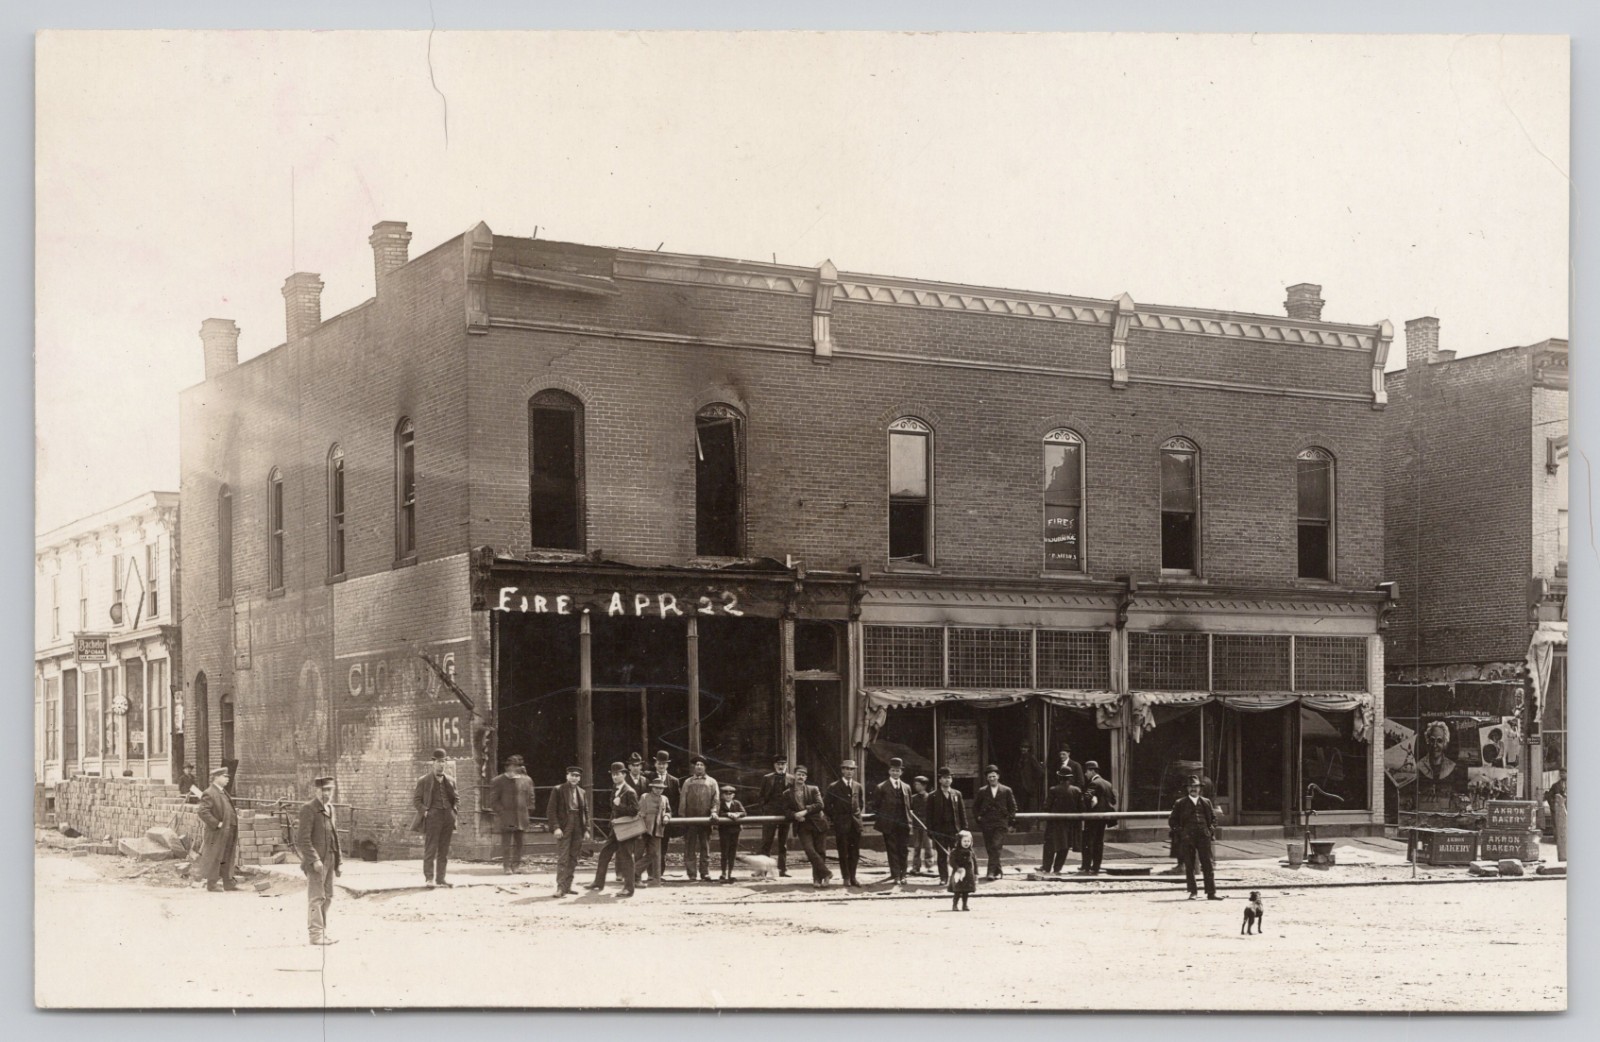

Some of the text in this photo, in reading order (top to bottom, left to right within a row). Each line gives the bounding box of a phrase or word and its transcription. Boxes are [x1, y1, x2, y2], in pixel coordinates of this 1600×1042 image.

[1493, 807, 1526, 815] AKRON
[1491, 815, 1527, 823] BAKERY
[1488, 836, 1520, 844] AKRON
[1439, 844, 1471, 853] BAKERY
[1486, 844, 1522, 853] BAKERY
